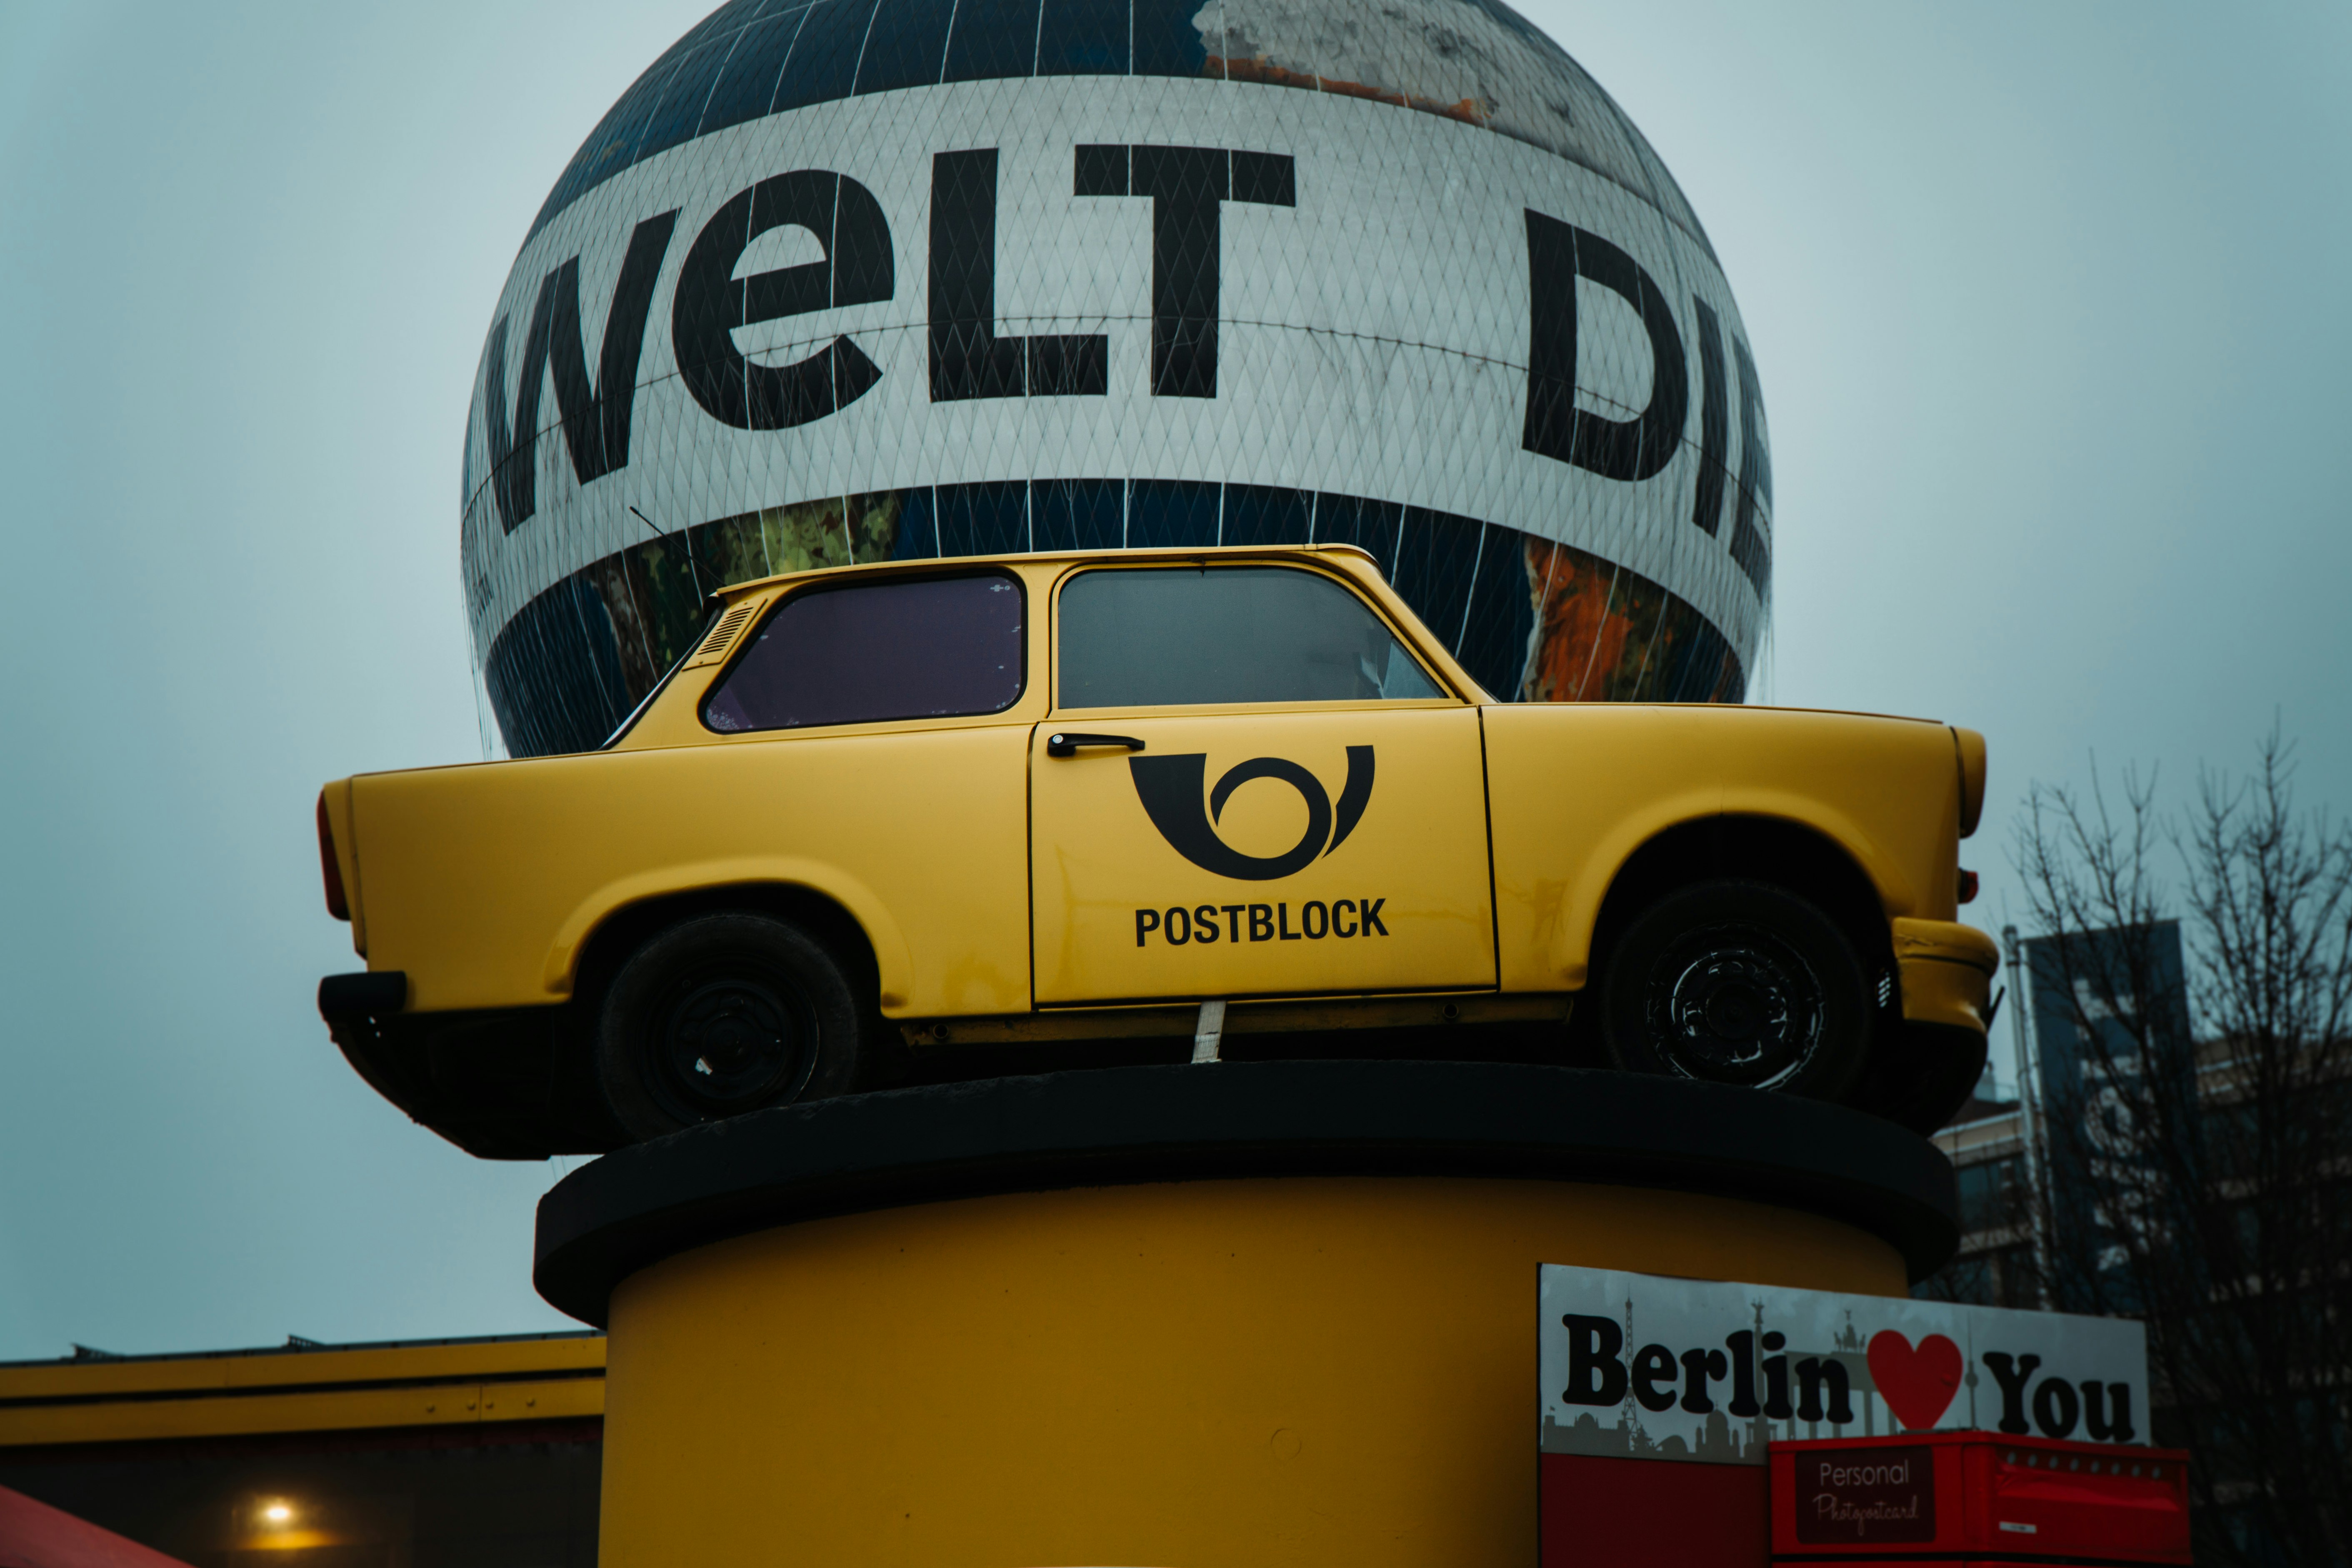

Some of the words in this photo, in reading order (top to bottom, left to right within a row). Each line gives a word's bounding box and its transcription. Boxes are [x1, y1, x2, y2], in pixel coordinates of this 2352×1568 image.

[1135, 898, 1390, 948] POSTBLOCK
[1562, 1313, 1853, 1423] Berlin
[1983, 1351, 2135, 1441] You
[1820, 1459, 1909, 1487] Personal
